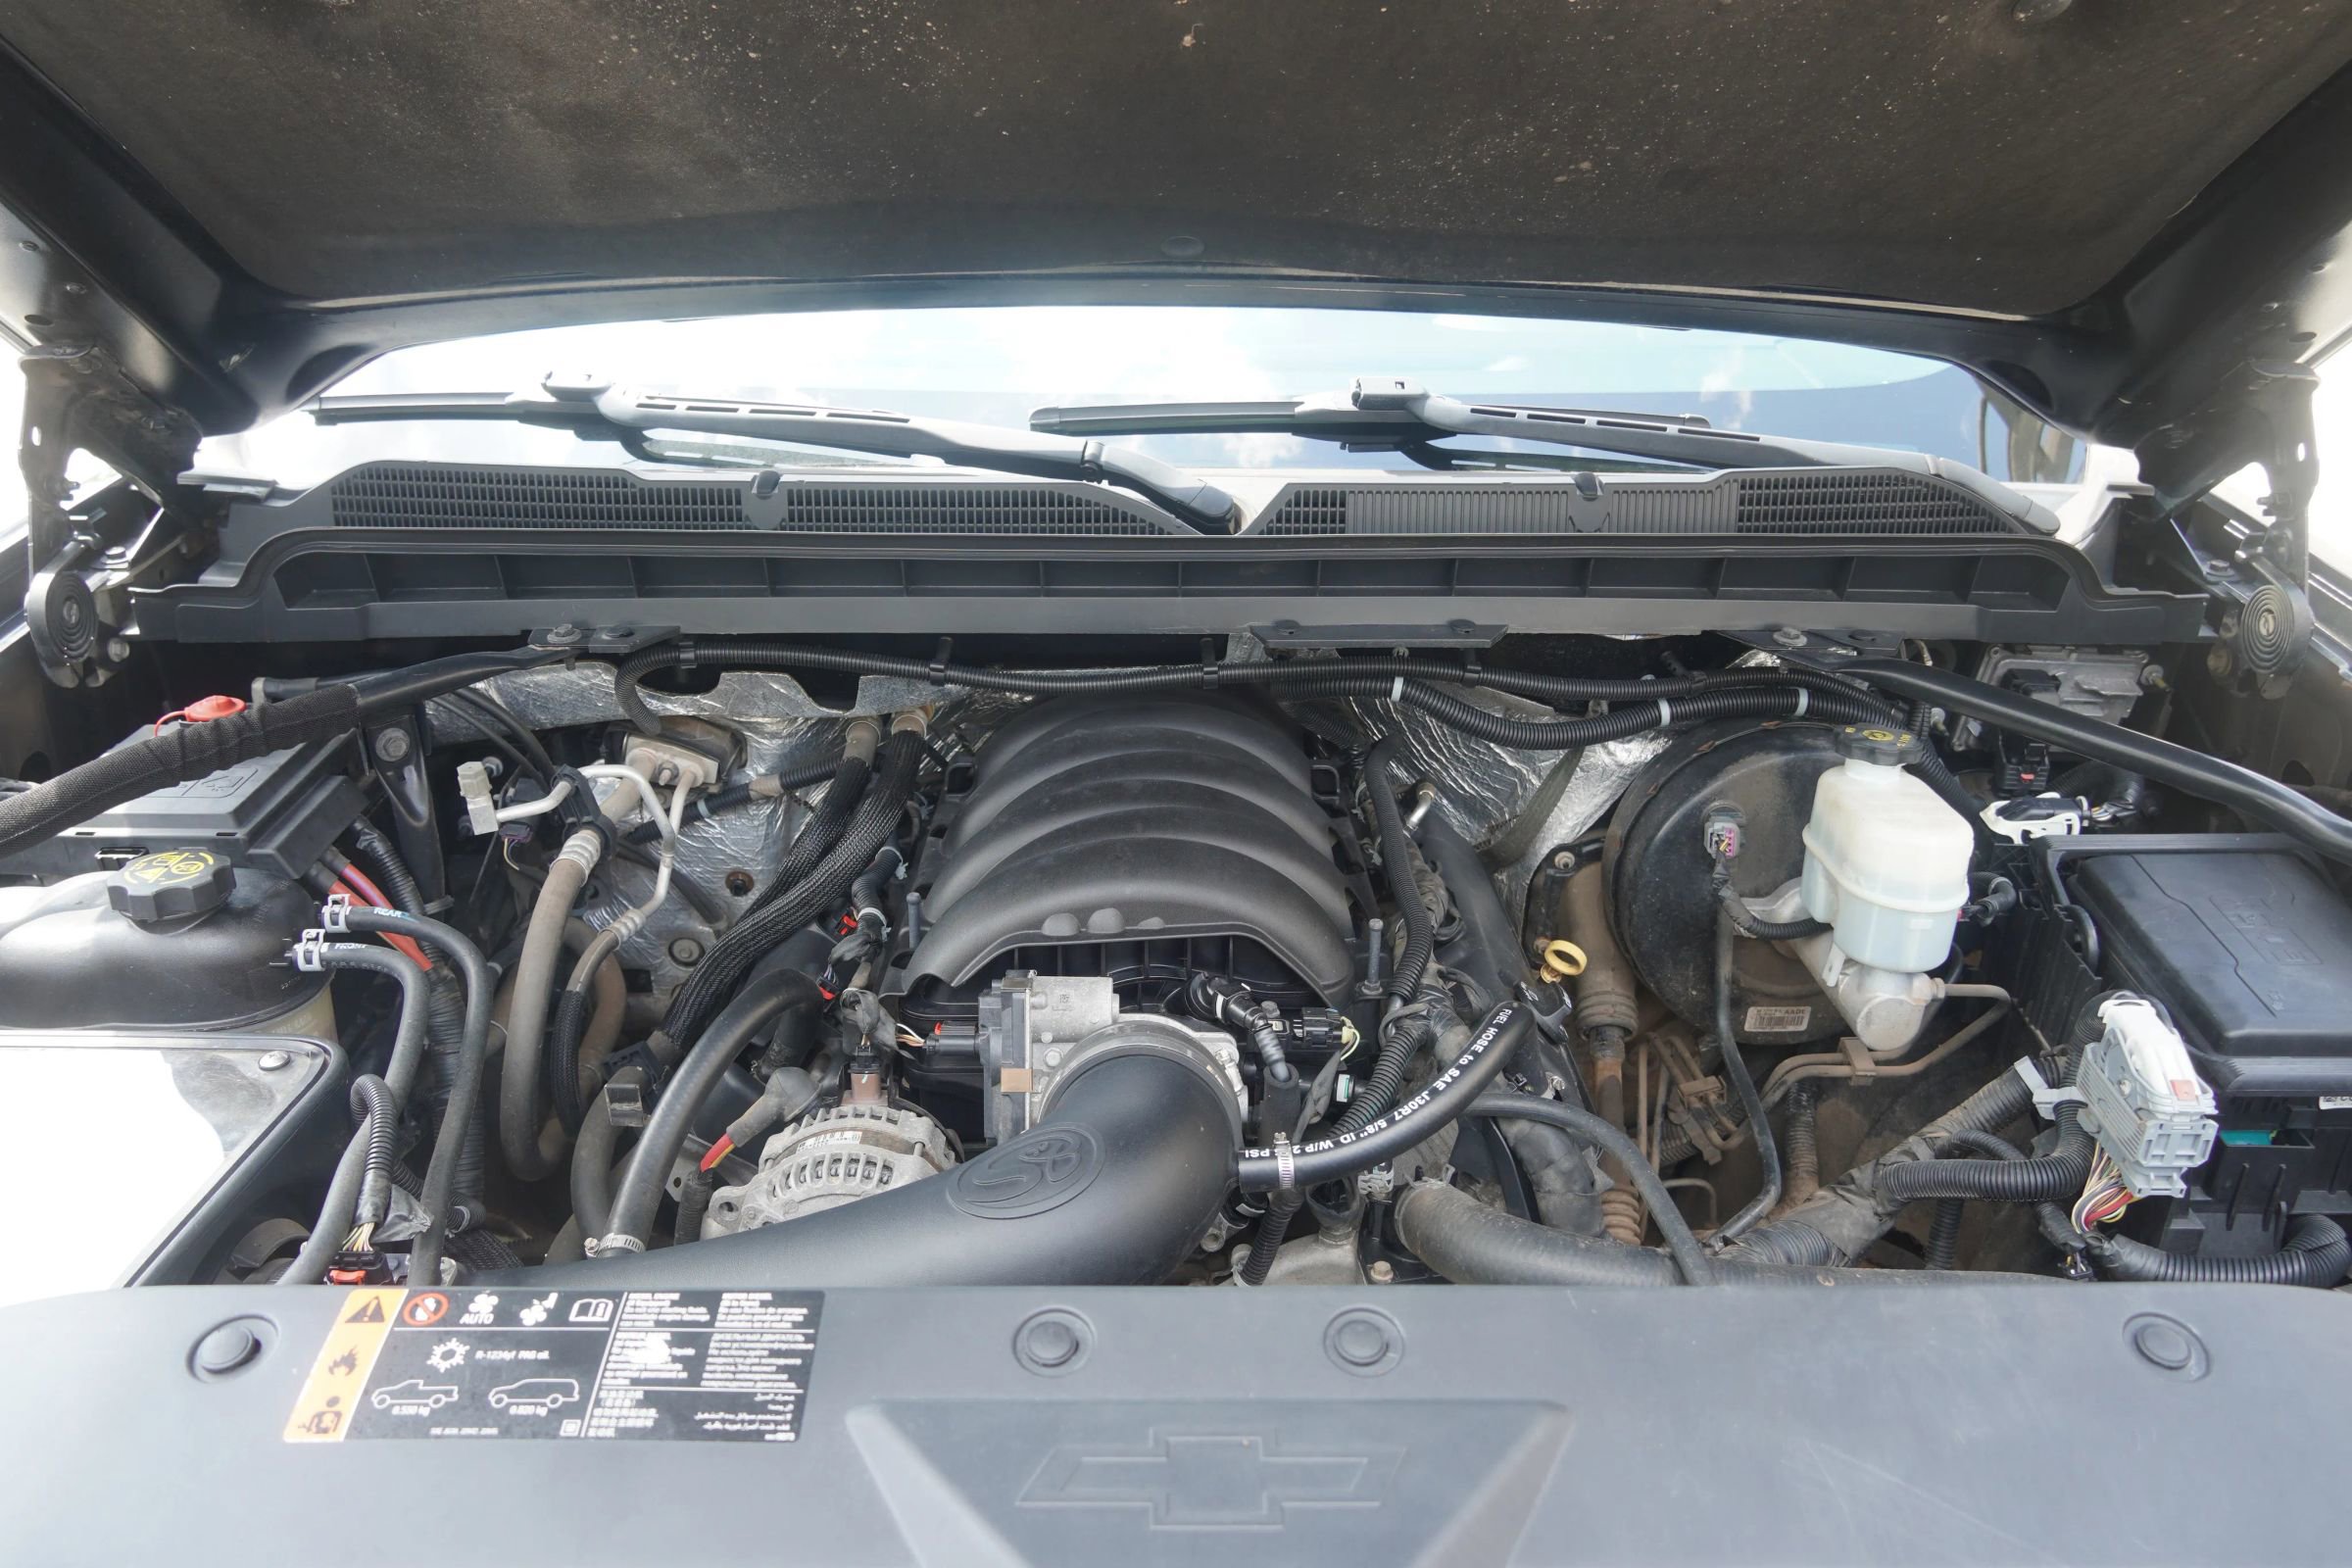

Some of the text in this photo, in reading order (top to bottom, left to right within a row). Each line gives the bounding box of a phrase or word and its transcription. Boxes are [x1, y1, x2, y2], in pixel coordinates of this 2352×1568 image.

[1493, 1008, 1512, 1024] FUEL
[1471, 1027, 1498, 1053] HOSE
[1459, 1054, 1474, 1065] to
[1433, 1067, 1460, 1091] SAE
[1394, 1091, 1430, 1121] J30R7
[1340, 1132, 1356, 1144] ID
[1304, 1140, 1334, 1152] W/P
[1245, 1148, 1270, 1158] PSI
[459, 1313, 494, 1324] AUTO
